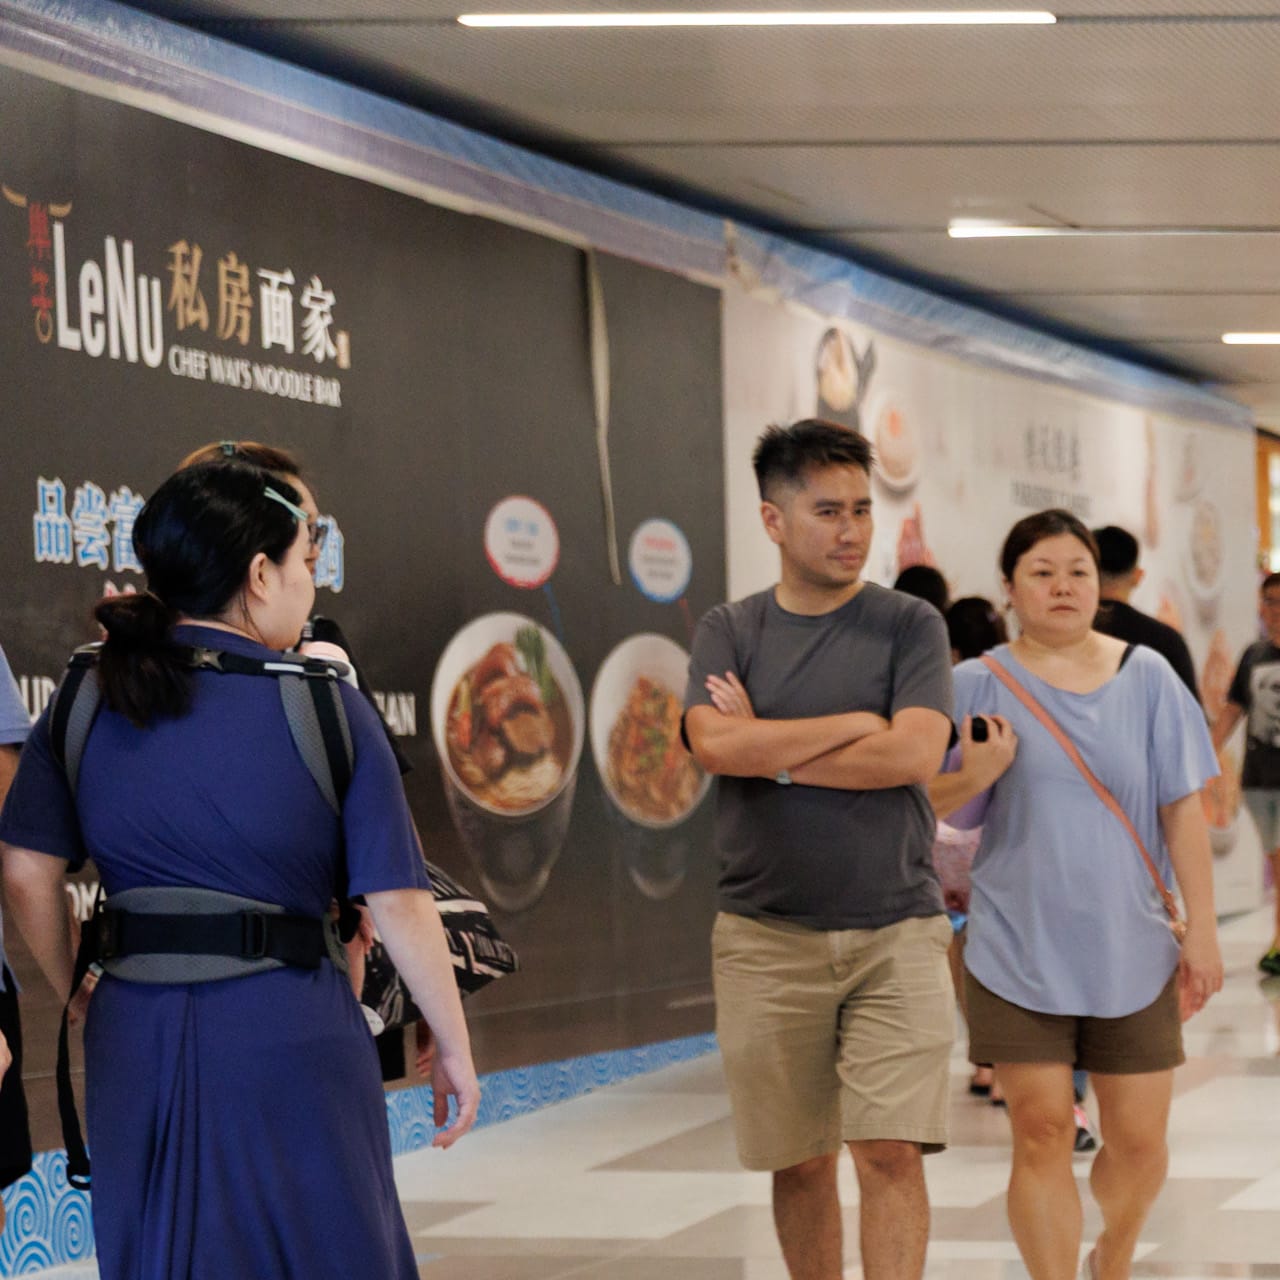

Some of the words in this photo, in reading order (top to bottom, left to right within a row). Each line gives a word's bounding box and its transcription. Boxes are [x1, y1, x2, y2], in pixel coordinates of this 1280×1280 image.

[53, 221, 164, 368] LeNu
[166, 238, 338, 363] 私房面家
